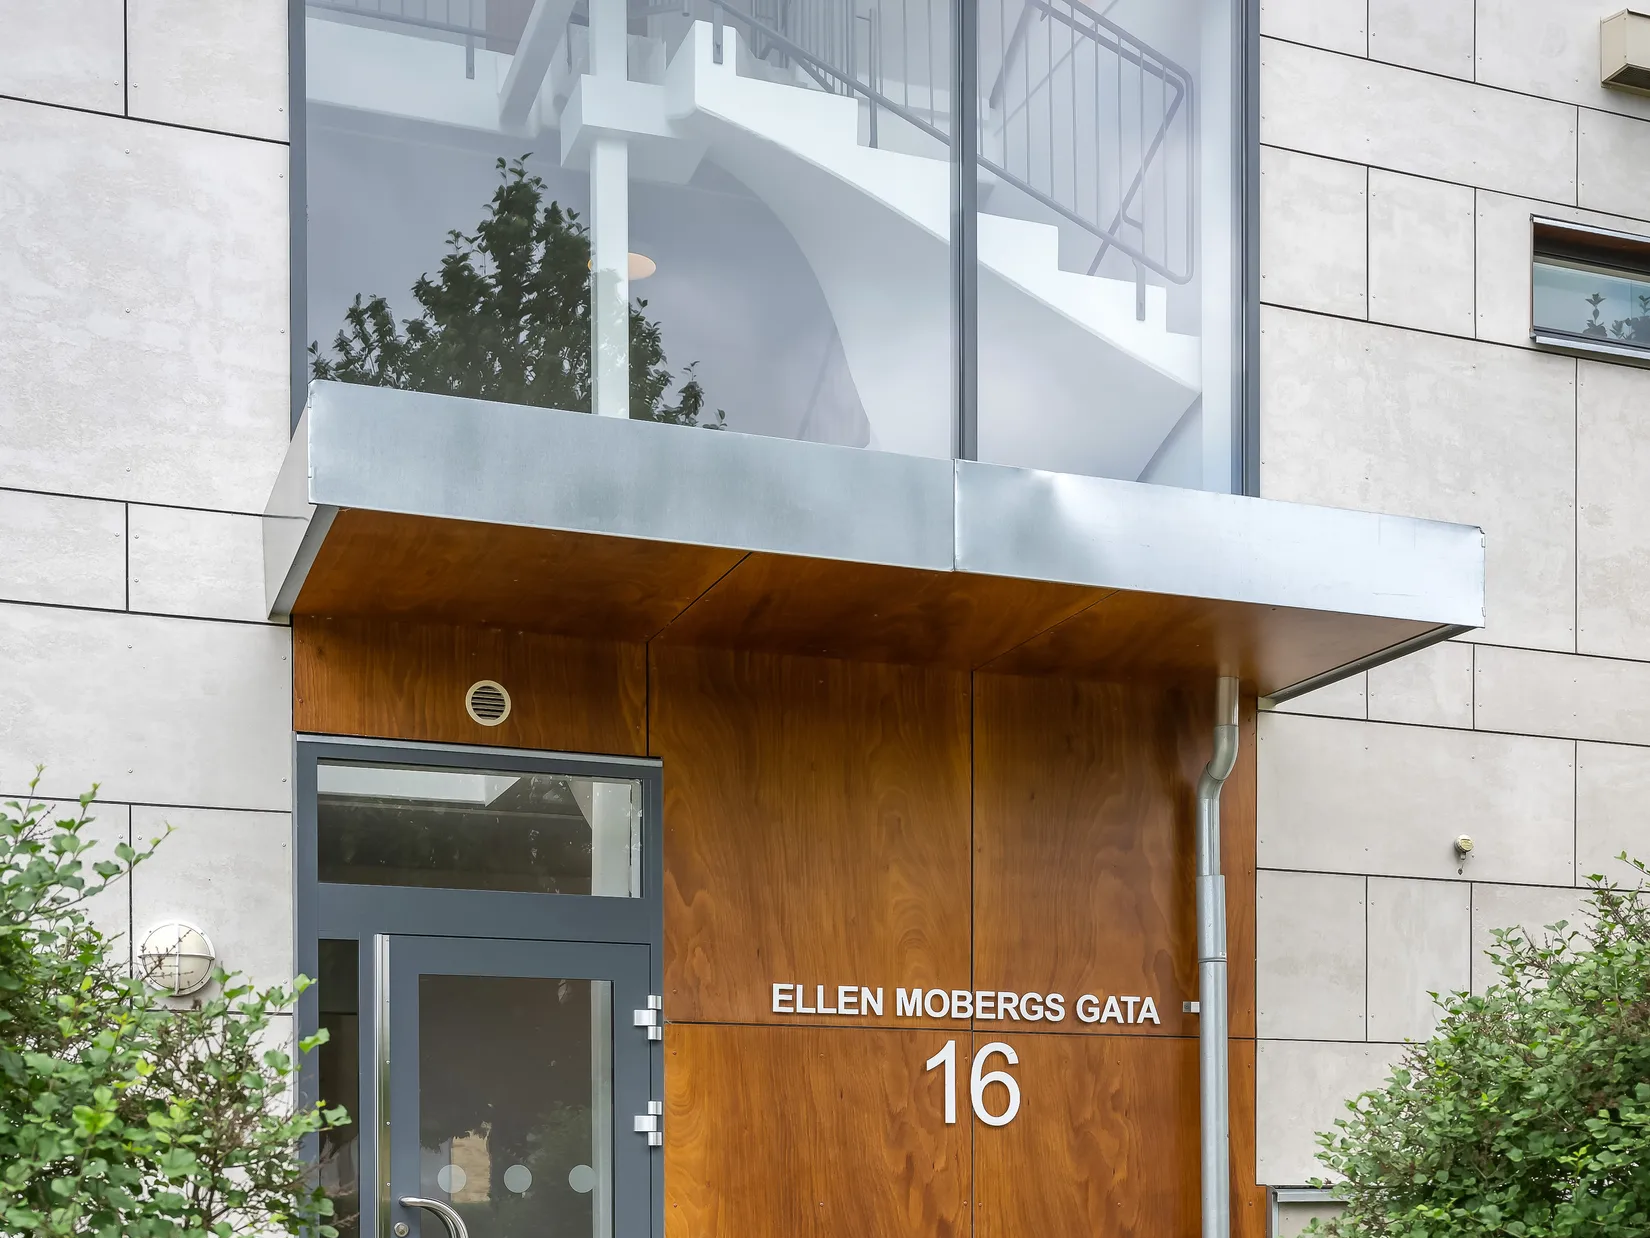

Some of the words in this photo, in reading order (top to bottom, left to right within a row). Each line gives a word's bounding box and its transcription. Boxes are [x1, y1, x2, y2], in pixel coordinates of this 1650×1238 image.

[771, 983, 884, 1016] ELLEN
[896, 987, 1066, 1022] MOBERGS
[1076, 994, 1161, 1025] GATA
[926, 1039, 1021, 1127] 16
